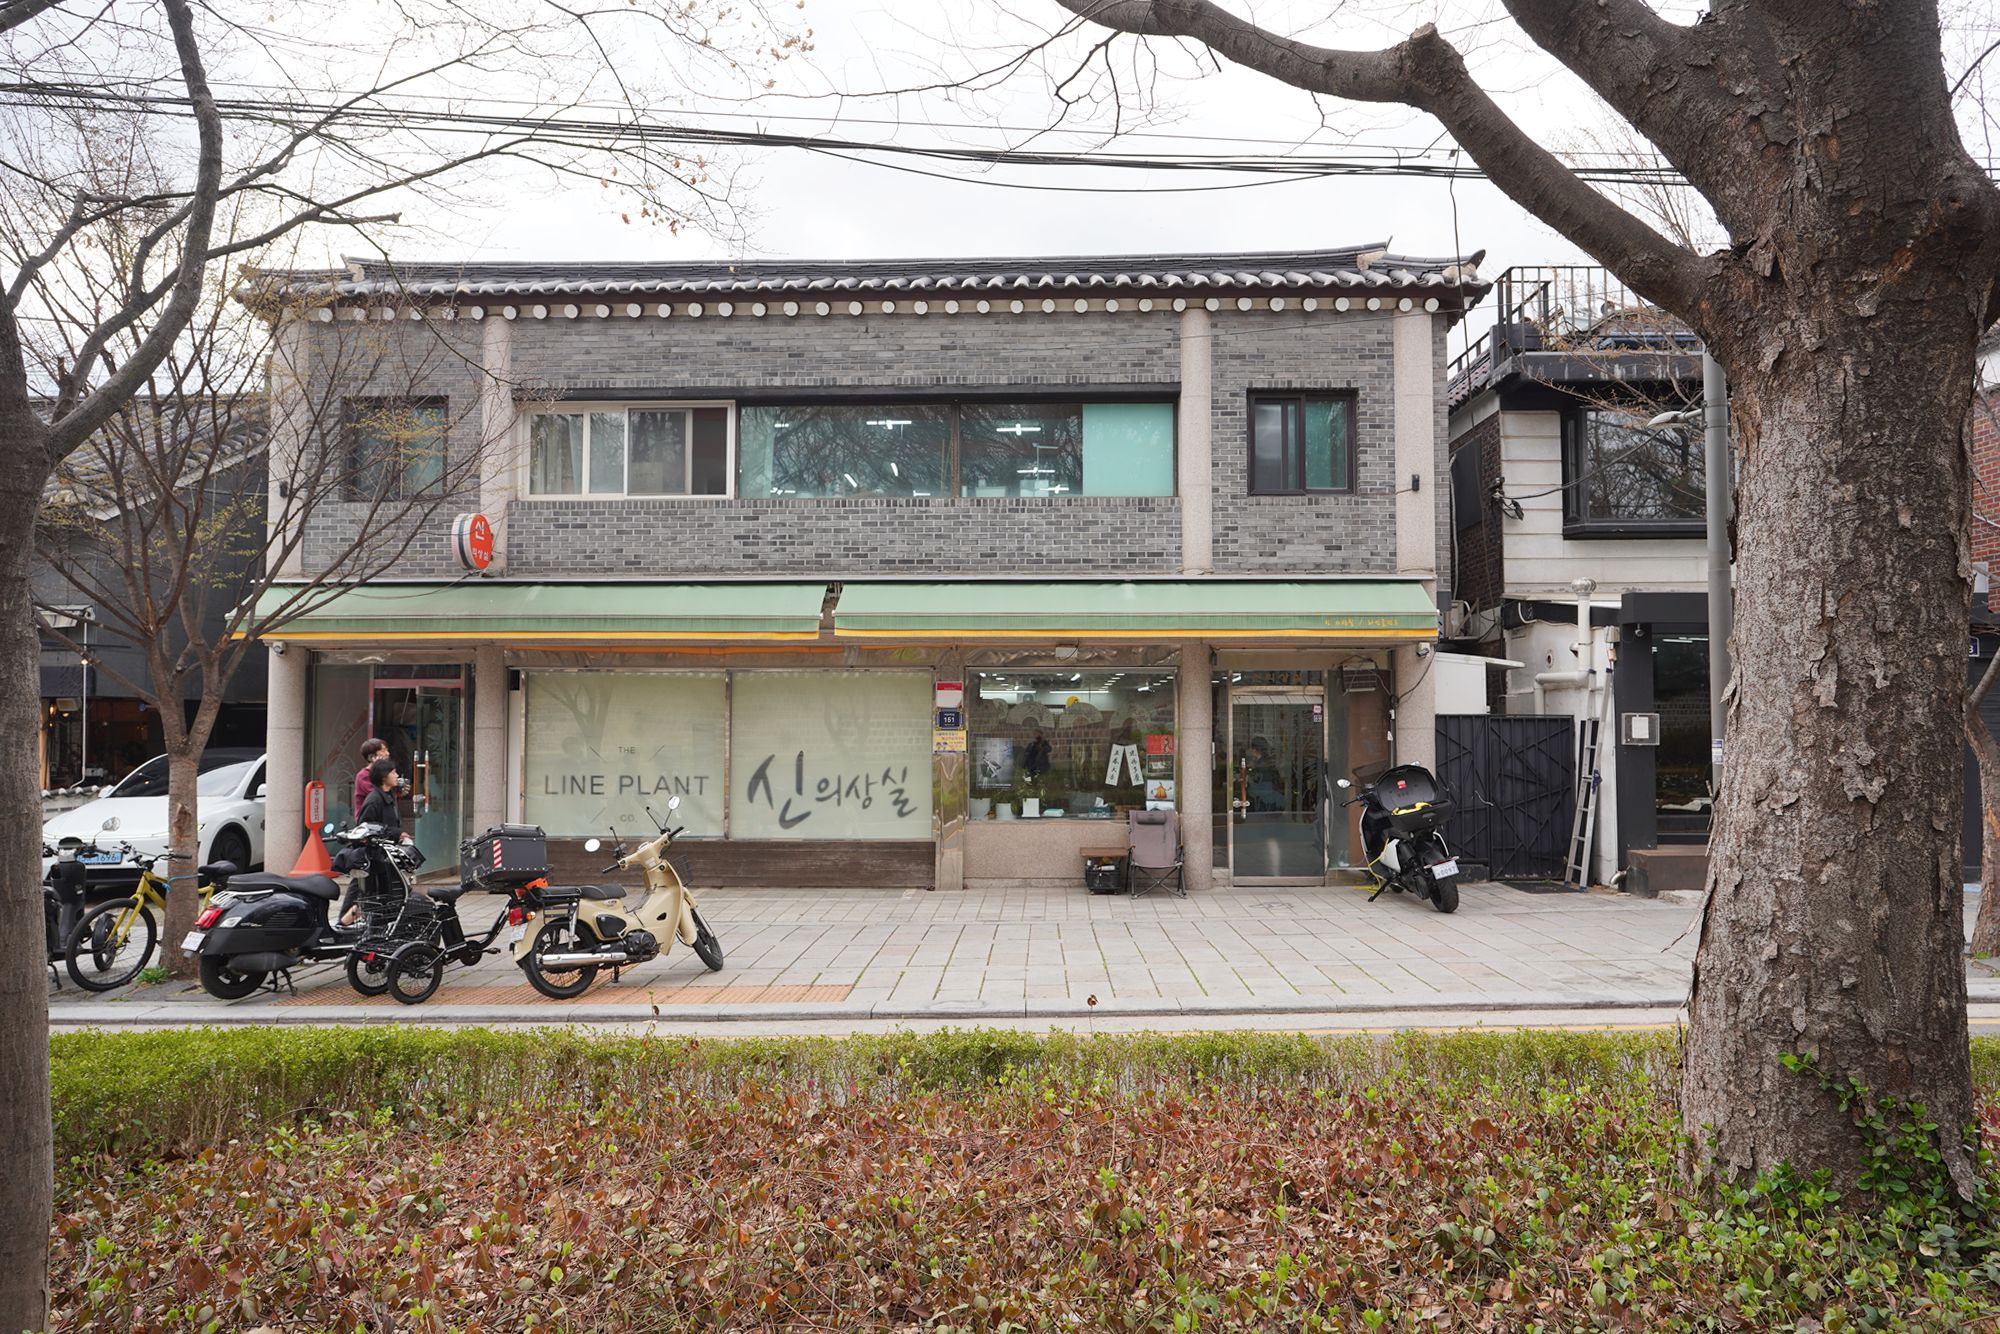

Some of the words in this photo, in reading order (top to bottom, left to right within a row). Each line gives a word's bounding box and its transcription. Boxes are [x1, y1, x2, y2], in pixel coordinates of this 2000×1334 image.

[475, 520, 485, 541] 신
[472, 547, 489, 562] 의상실
[618, 746, 636, 754] THE
[545, 775, 605, 795] LINE
[619, 775, 710, 796] PLANT
[747, 750, 918, 829] 신의상실
